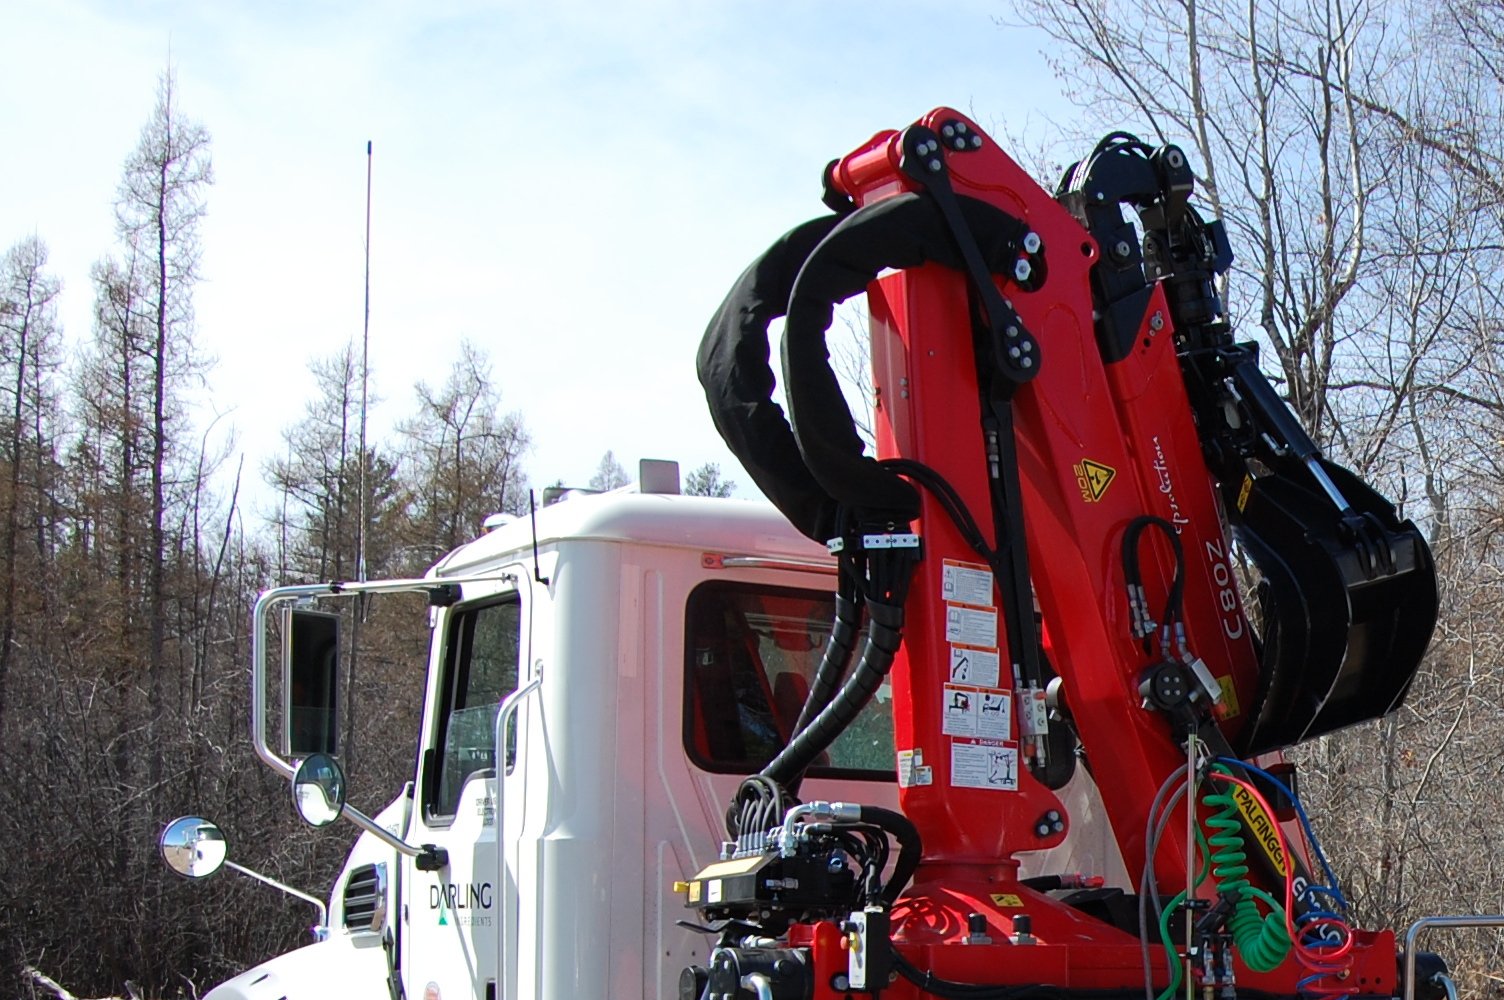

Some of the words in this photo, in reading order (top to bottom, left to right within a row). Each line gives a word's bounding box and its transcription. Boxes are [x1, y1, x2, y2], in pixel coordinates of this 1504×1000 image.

[1073, 464, 1092, 503] 20M
[1205, 538, 1243, 640] C80Z
[430, 883, 492, 909] DARLING
